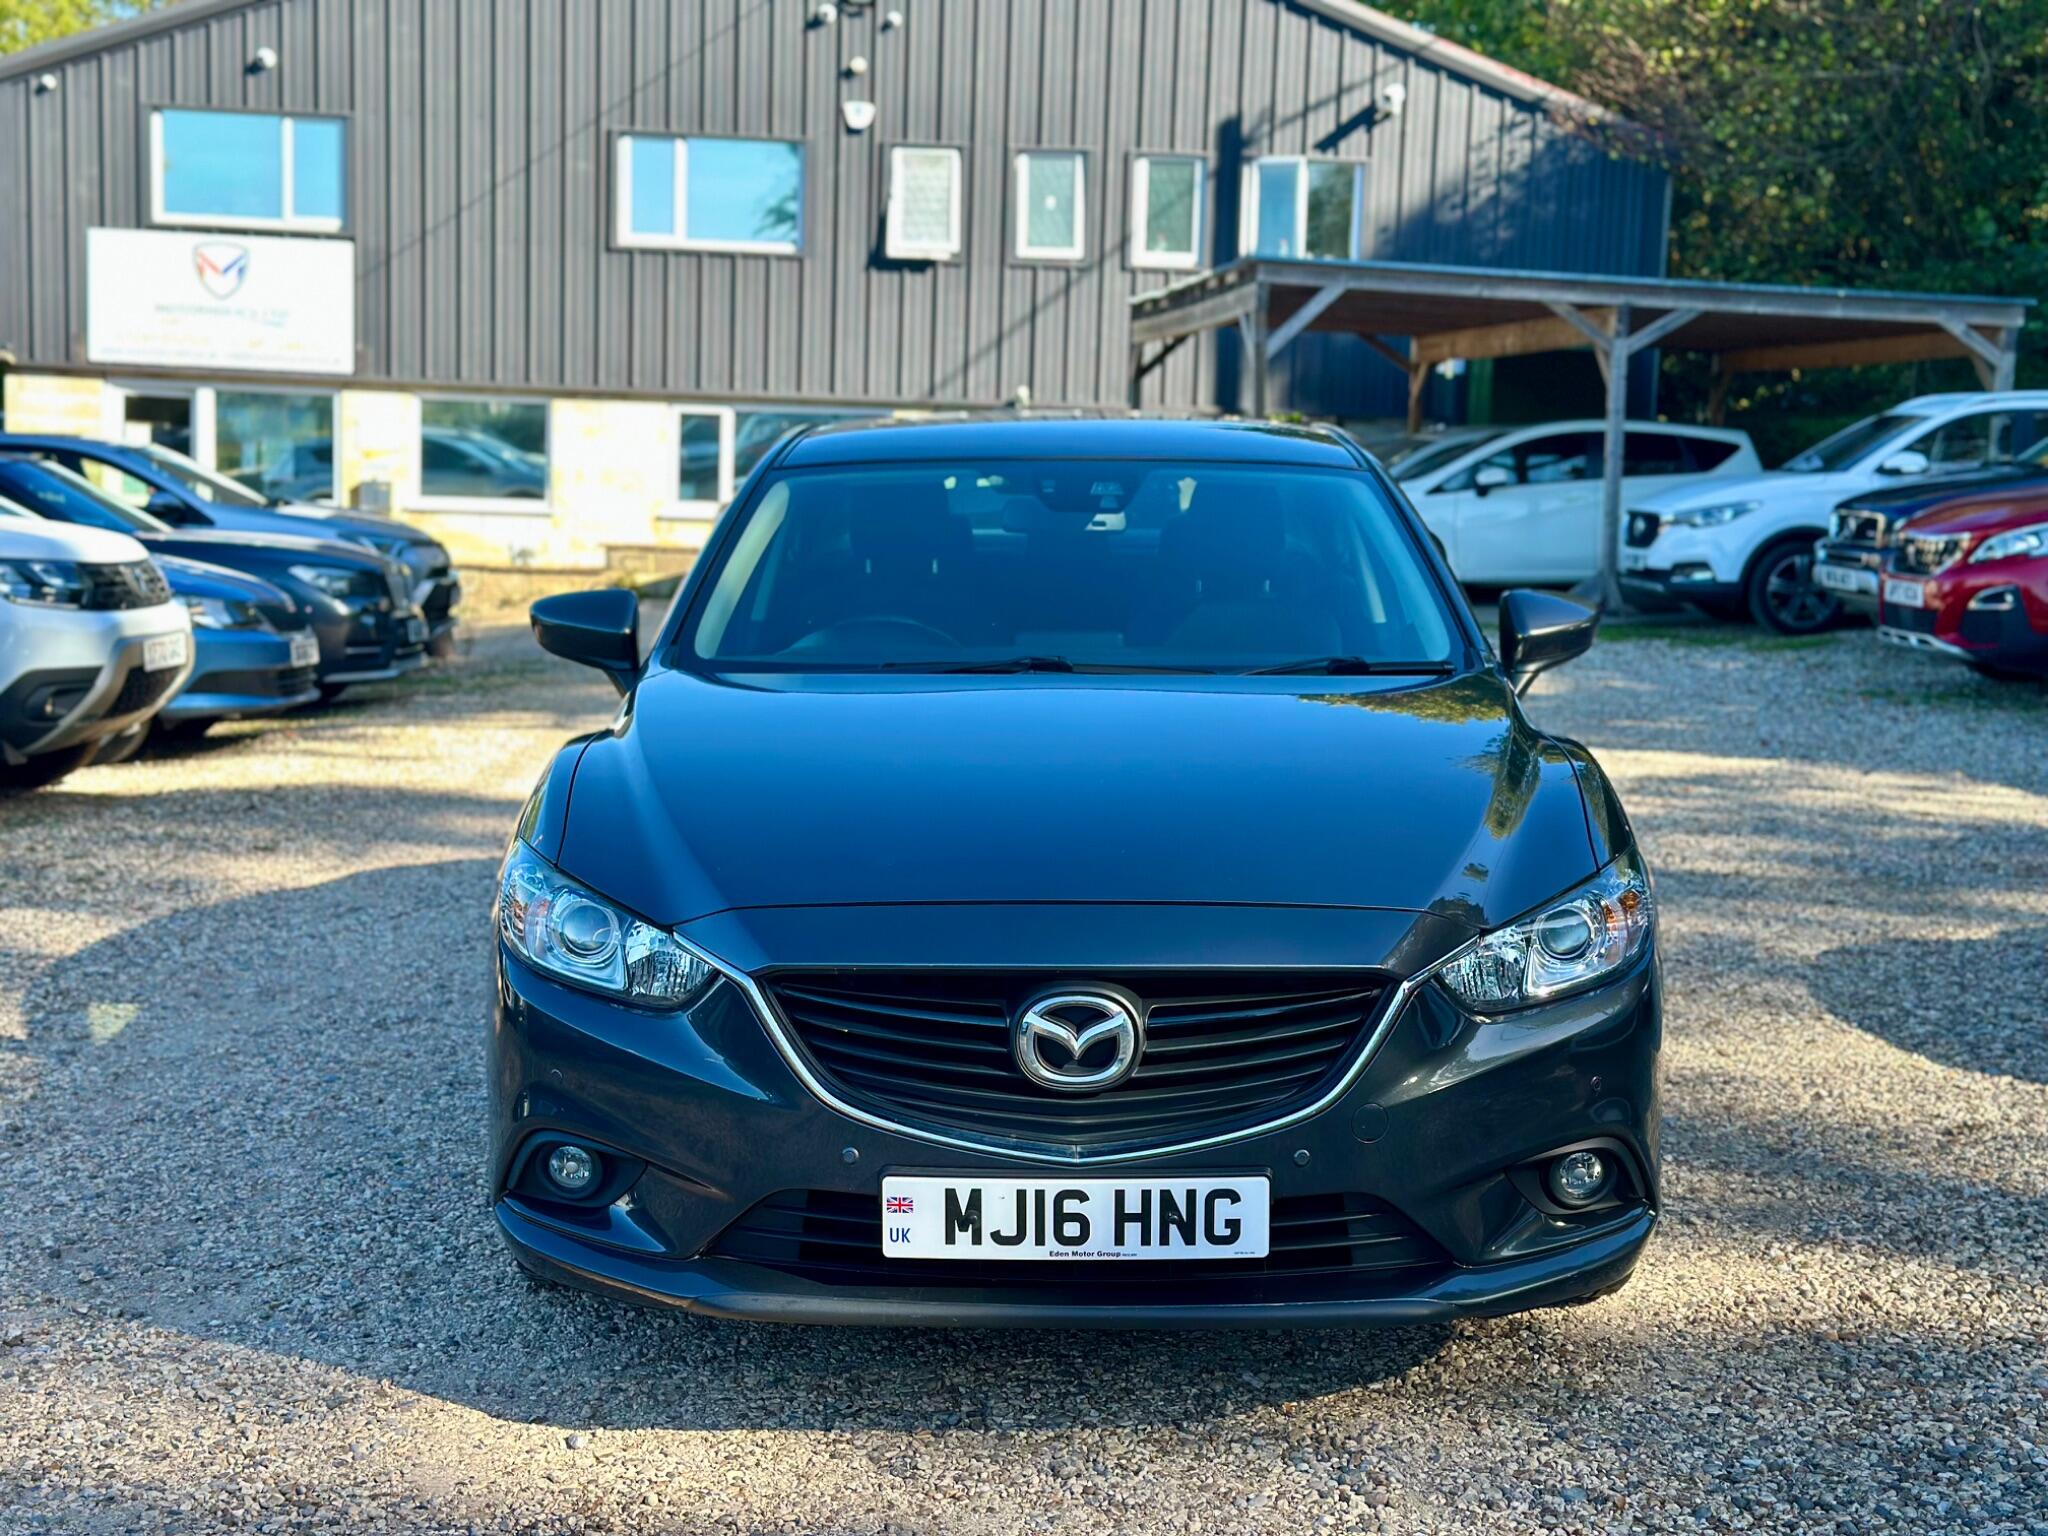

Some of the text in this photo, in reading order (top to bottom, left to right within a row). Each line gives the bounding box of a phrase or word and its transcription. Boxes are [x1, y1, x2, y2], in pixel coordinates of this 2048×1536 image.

[945, 1188, 1242, 1247] MJ16 HNG
[889, 1228, 911, 1243] UK
[1096, 1250, 1121, 1258] Group
